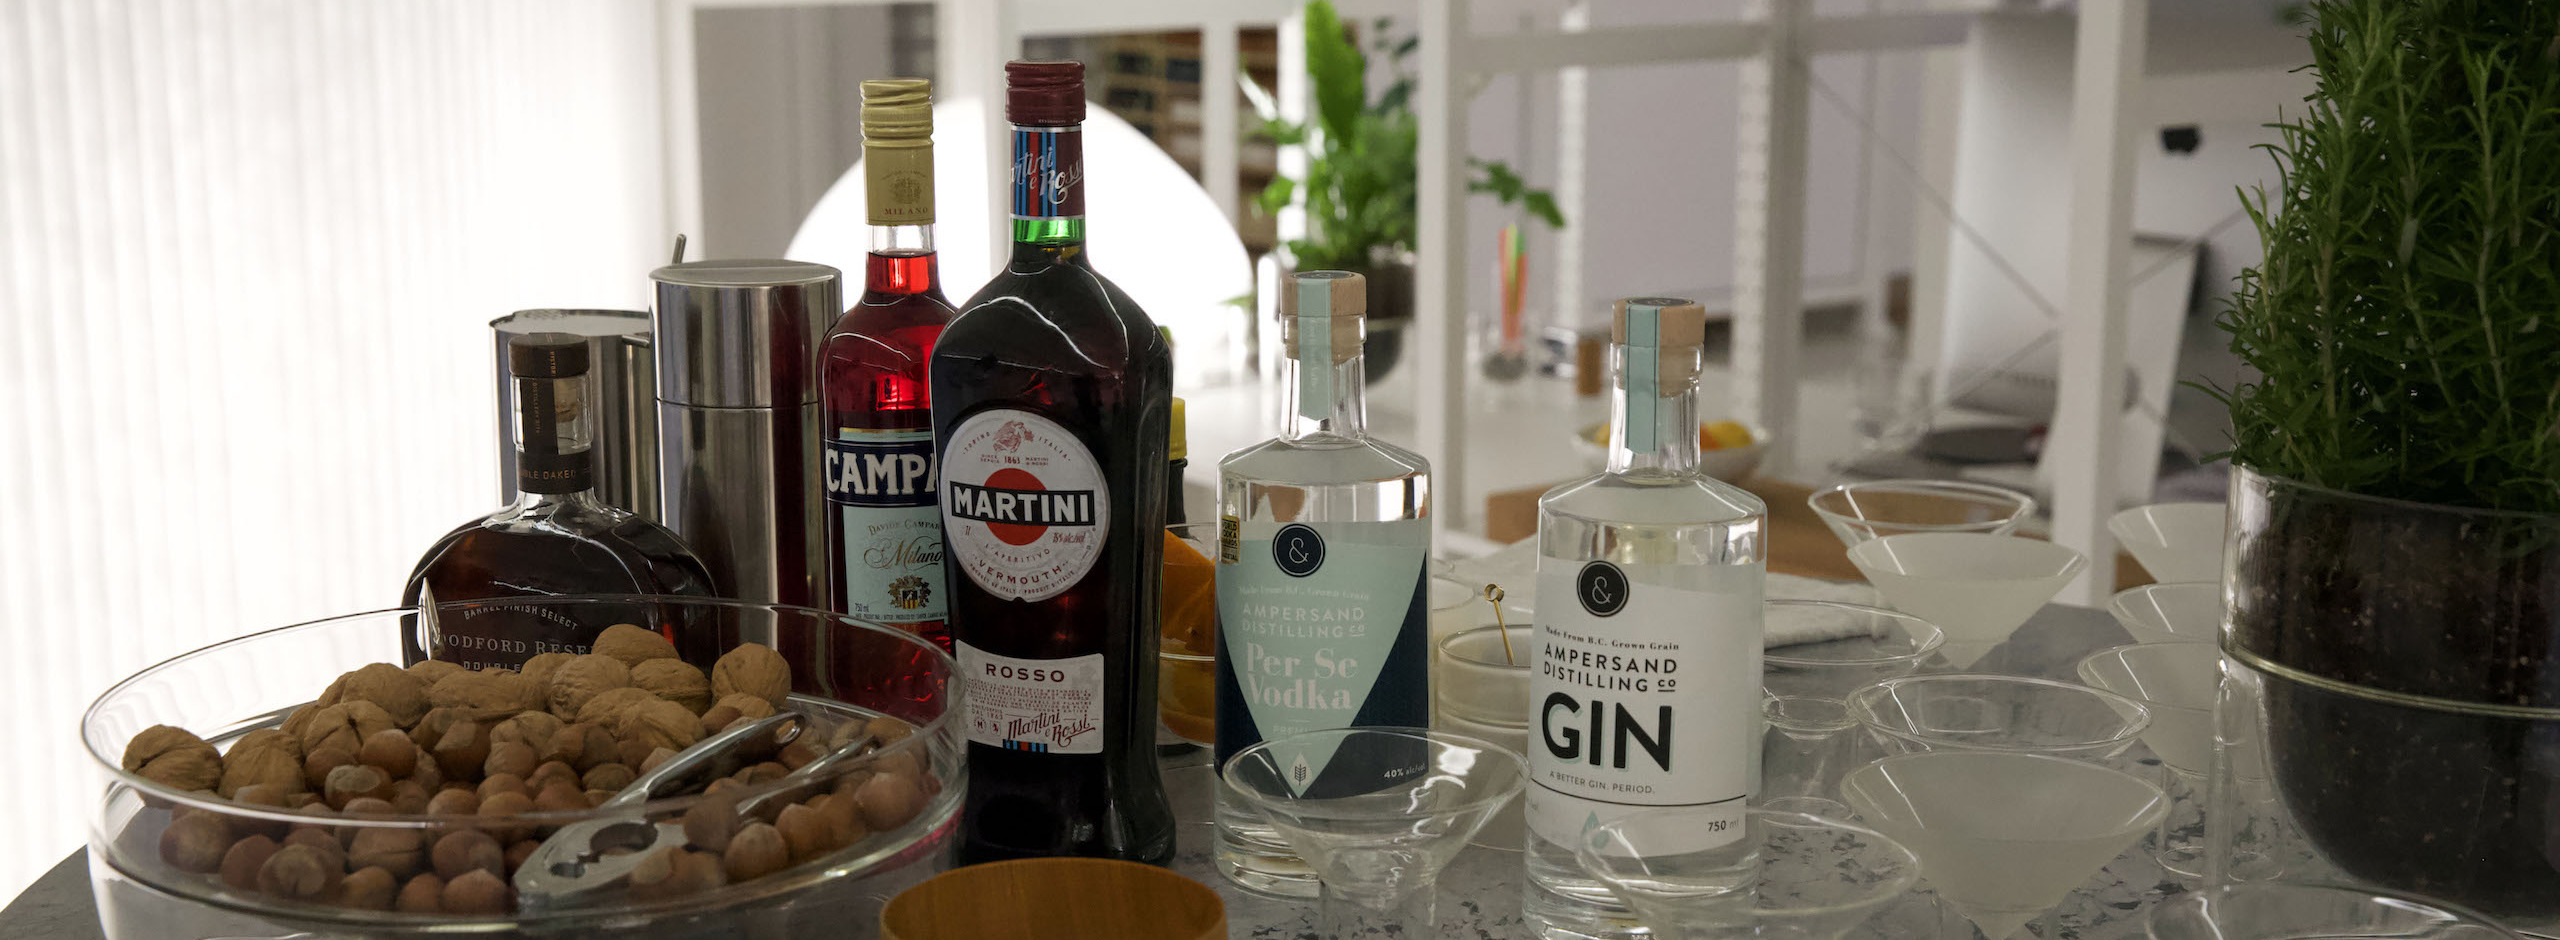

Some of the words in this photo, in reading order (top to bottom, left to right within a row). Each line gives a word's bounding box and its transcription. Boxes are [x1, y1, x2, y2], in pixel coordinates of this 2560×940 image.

[884, 207, 928, 215] MILANO
[965, 431, 990, 451] TORINO
[1038, 436, 1068, 459] ITALIA
[1004, 456, 1020, 464] 1863
[954, 485, 1090, 523] MARTINI
[864, 536, 943, 571] Milano
[979, 559, 1062, 585] VERMOUTH
[541, 608, 578, 631] SELECT
[1242, 602, 1365, 621] AMPERSAND
[1242, 620, 1344, 638] DISTILLING
[1545, 624, 1561, 637] Made
[1563, 631, 1585, 642] From
[1588, 636, 1607, 646] B.C.
[1611, 639, 1646, 650] Grown
[1649, 641, 1680, 651] Grain
[1247, 642, 1301, 677] Per
[1314, 647, 1358, 679] Se
[1544, 642, 1677, 674] AMPERSAND
[985, 662, 1065, 683] ROSSO
[1544, 661, 1648, 692] DISTILLING
[1247, 673, 1353, 710] Vodka
[1007, 709, 1061, 741] Martini
[1052, 713, 1096, 748] Rossi
[1542, 691, 1673, 772] GIN
[1384, 769, 1404, 779] 40%
[1549, 771, 1556, 779] A
[1556, 772, 1586, 787] BETTER
[1588, 780, 1609, 791] GIN.
[1612, 783, 1656, 795] PERIOD.
[1708, 820, 1727, 832] 750
